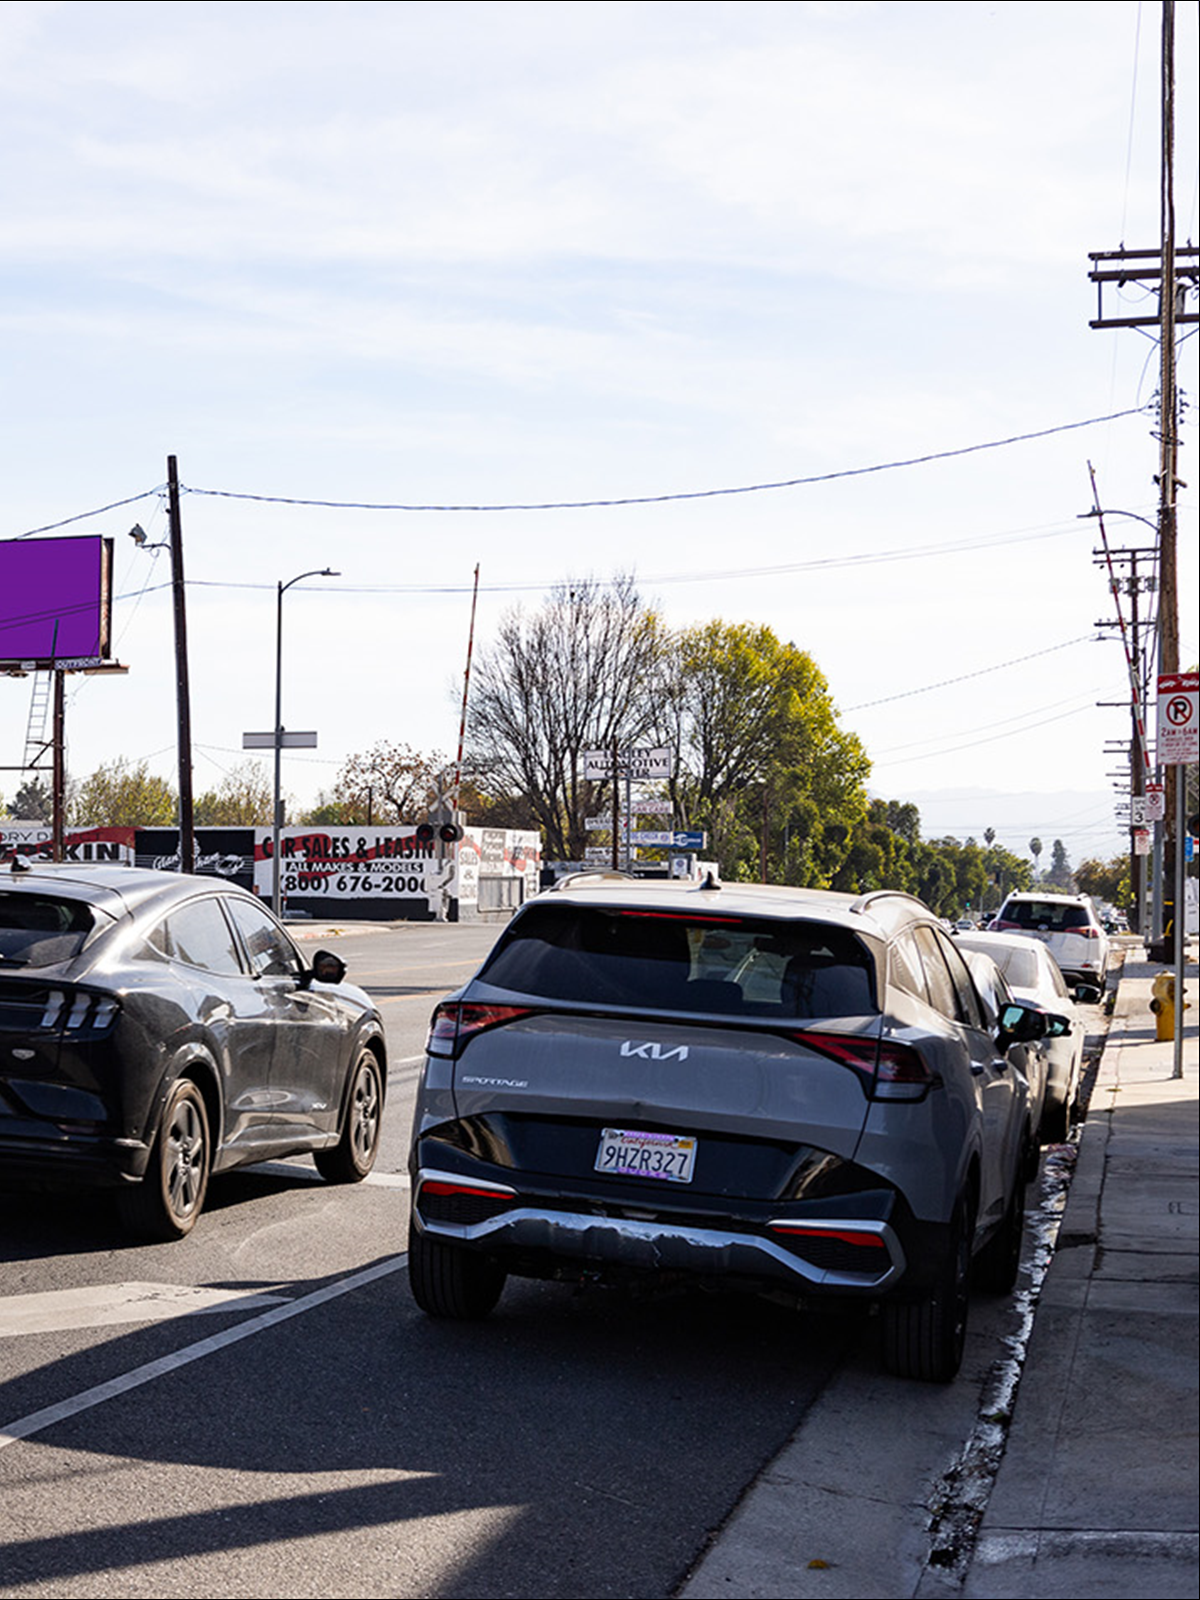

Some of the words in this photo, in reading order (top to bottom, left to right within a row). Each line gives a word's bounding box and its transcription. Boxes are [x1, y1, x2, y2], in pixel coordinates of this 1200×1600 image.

[36, 831, 102, 842] DECT
[262, 837, 296, 859] CR
[302, 836, 350, 859] SALES
[355, 837, 369, 858] &
[375, 837, 434, 859] LEASIN
[288, 863, 309, 872] ALL
[310, 862, 356, 872] MAKES
[370, 862, 421, 873] MODELS
[279, 875, 330, 894] (800)
[620, 1040, 689, 1061] KIA
[461, 1075, 529, 1088] SPORTAGE
[603, 1145, 689, 1175] 9HZR327
